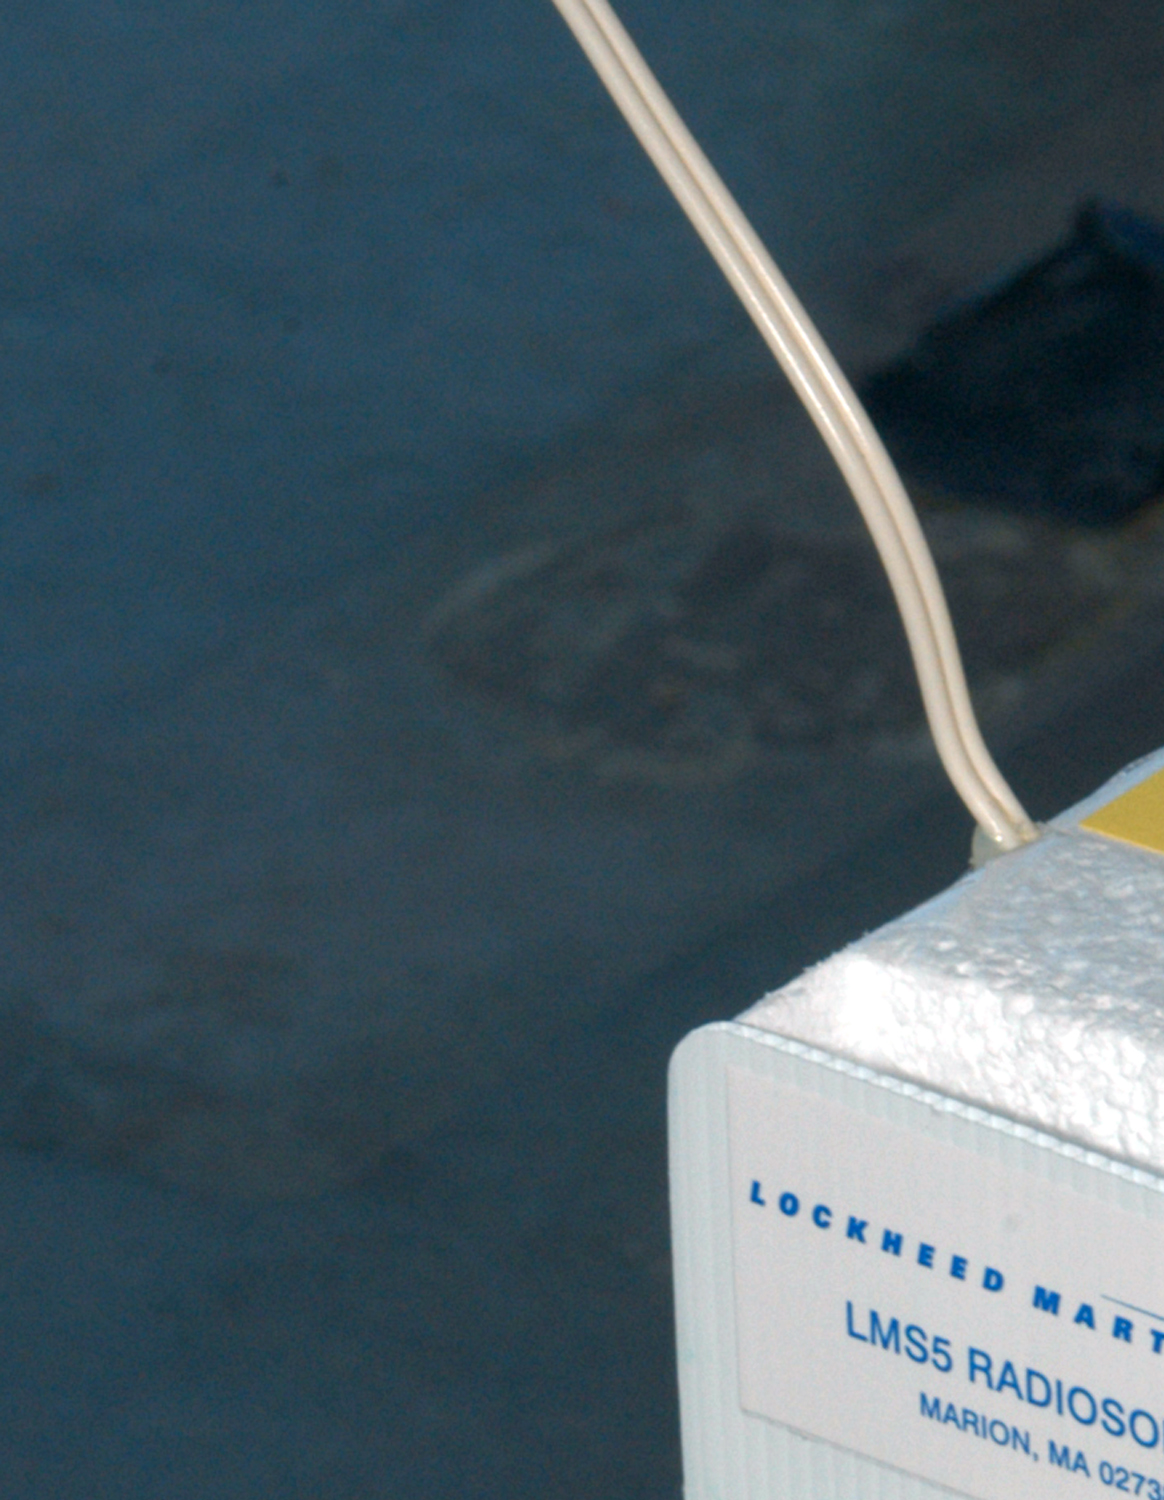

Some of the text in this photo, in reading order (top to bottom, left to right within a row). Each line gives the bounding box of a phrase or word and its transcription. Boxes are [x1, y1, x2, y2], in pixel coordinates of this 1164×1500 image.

[749, 1180, 1005, 1294] LOCKHEED
[845, 1300, 954, 1374] LMS5
[918, 1392, 1039, 1462] MARION,
[1047, 1440, 1092, 1479] MA
